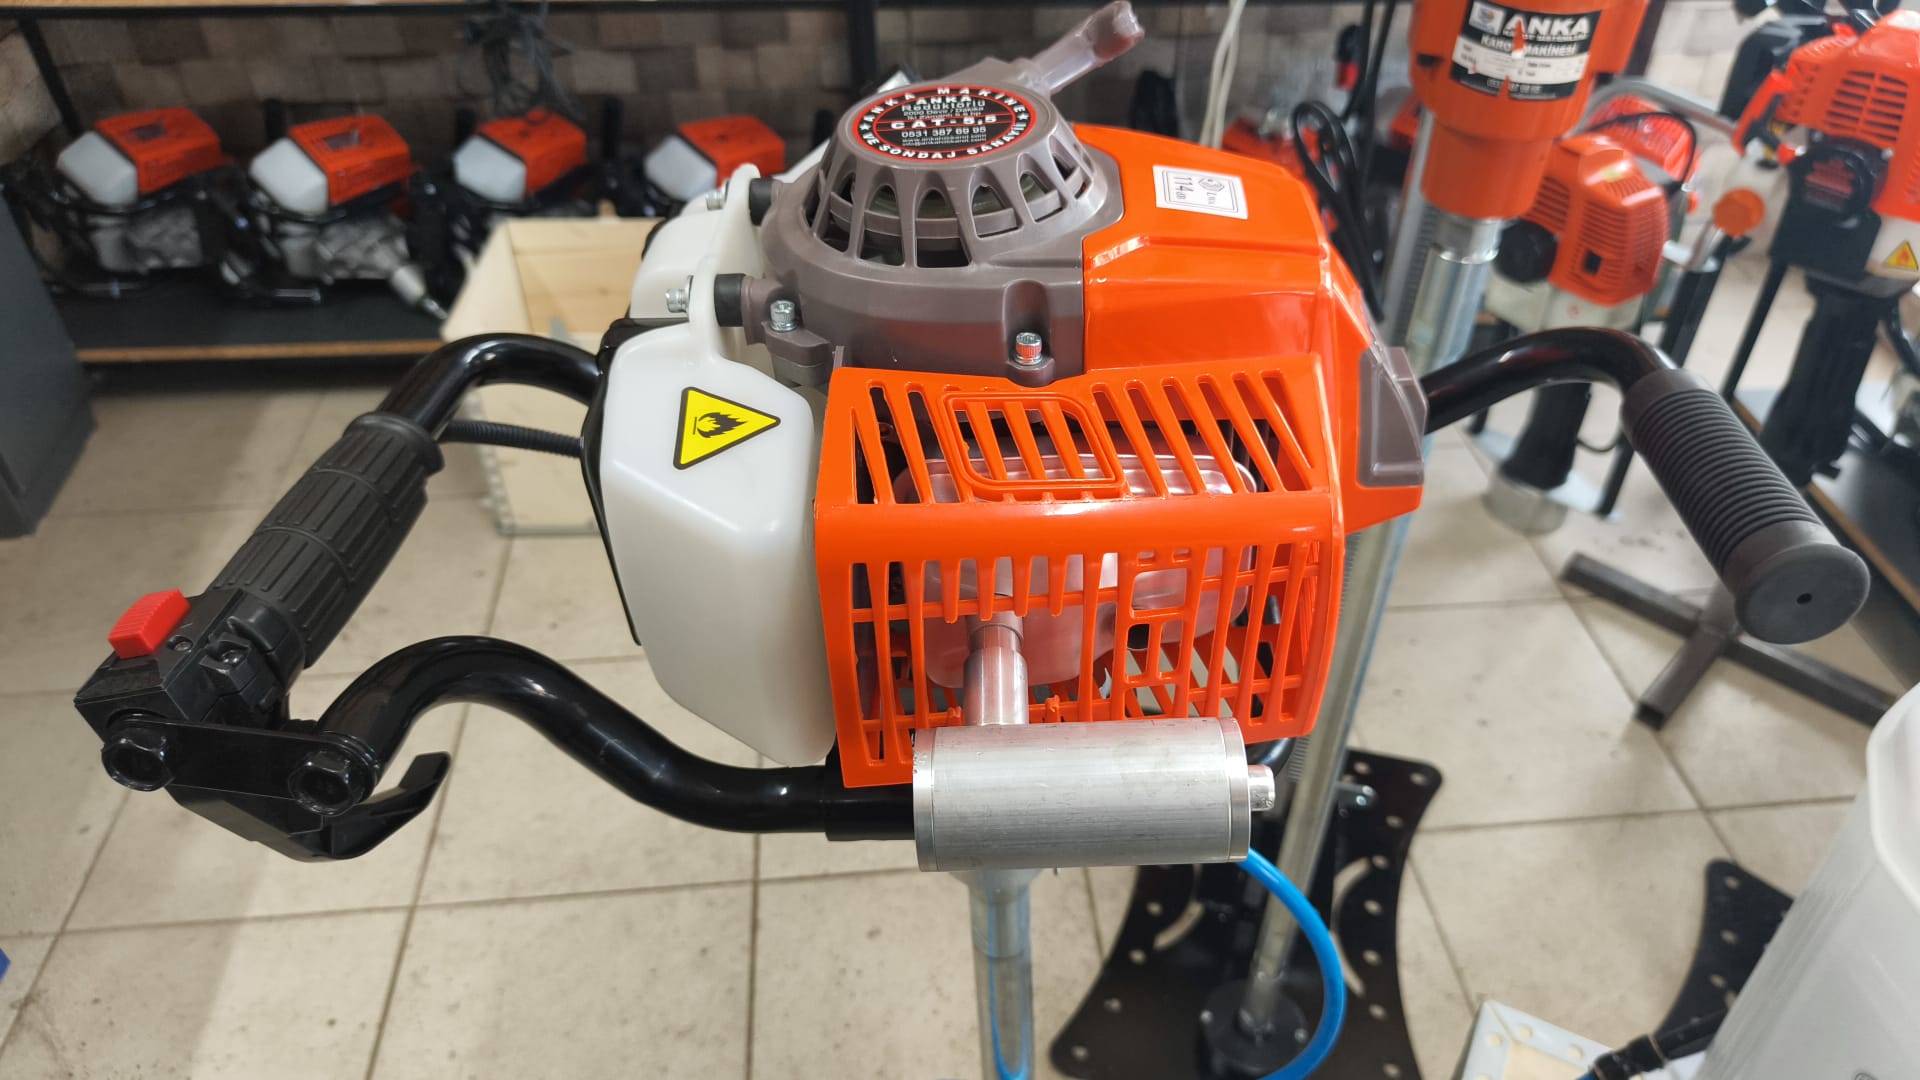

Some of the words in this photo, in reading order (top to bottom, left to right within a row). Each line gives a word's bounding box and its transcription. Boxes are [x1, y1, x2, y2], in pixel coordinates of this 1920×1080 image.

[1502, 13, 1591, 36] ANKA
[863, 92, 916, 122] ANKA
[916, 95, 972, 105] ANKA
[862, 132, 880, 146] VE
[879, 143, 956, 159] SONDAJ
